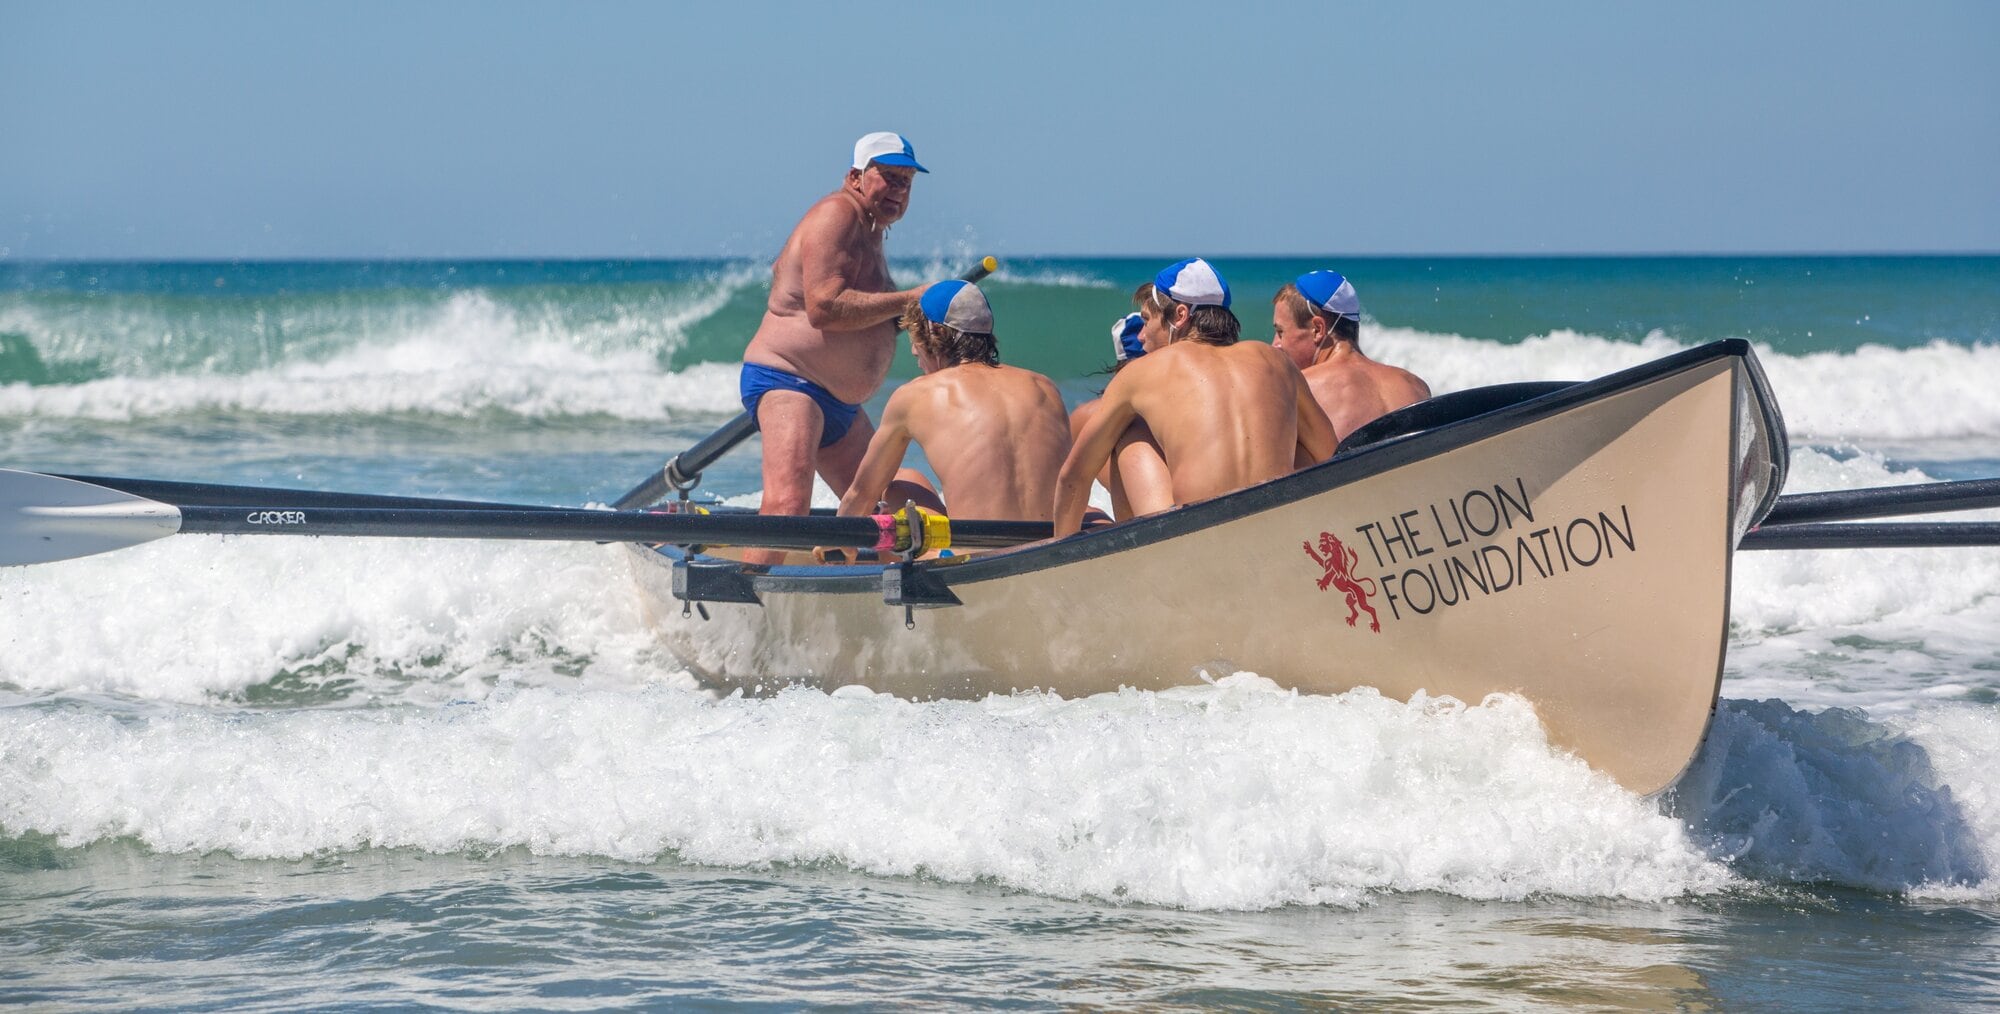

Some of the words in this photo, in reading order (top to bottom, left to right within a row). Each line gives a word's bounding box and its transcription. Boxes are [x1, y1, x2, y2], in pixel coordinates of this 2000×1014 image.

[246, 511, 306, 524] CROKER
[1356, 509, 1434, 567] THE
[1430, 477, 1534, 548] LION
[1380, 505, 1636, 620] FOUNDATION
